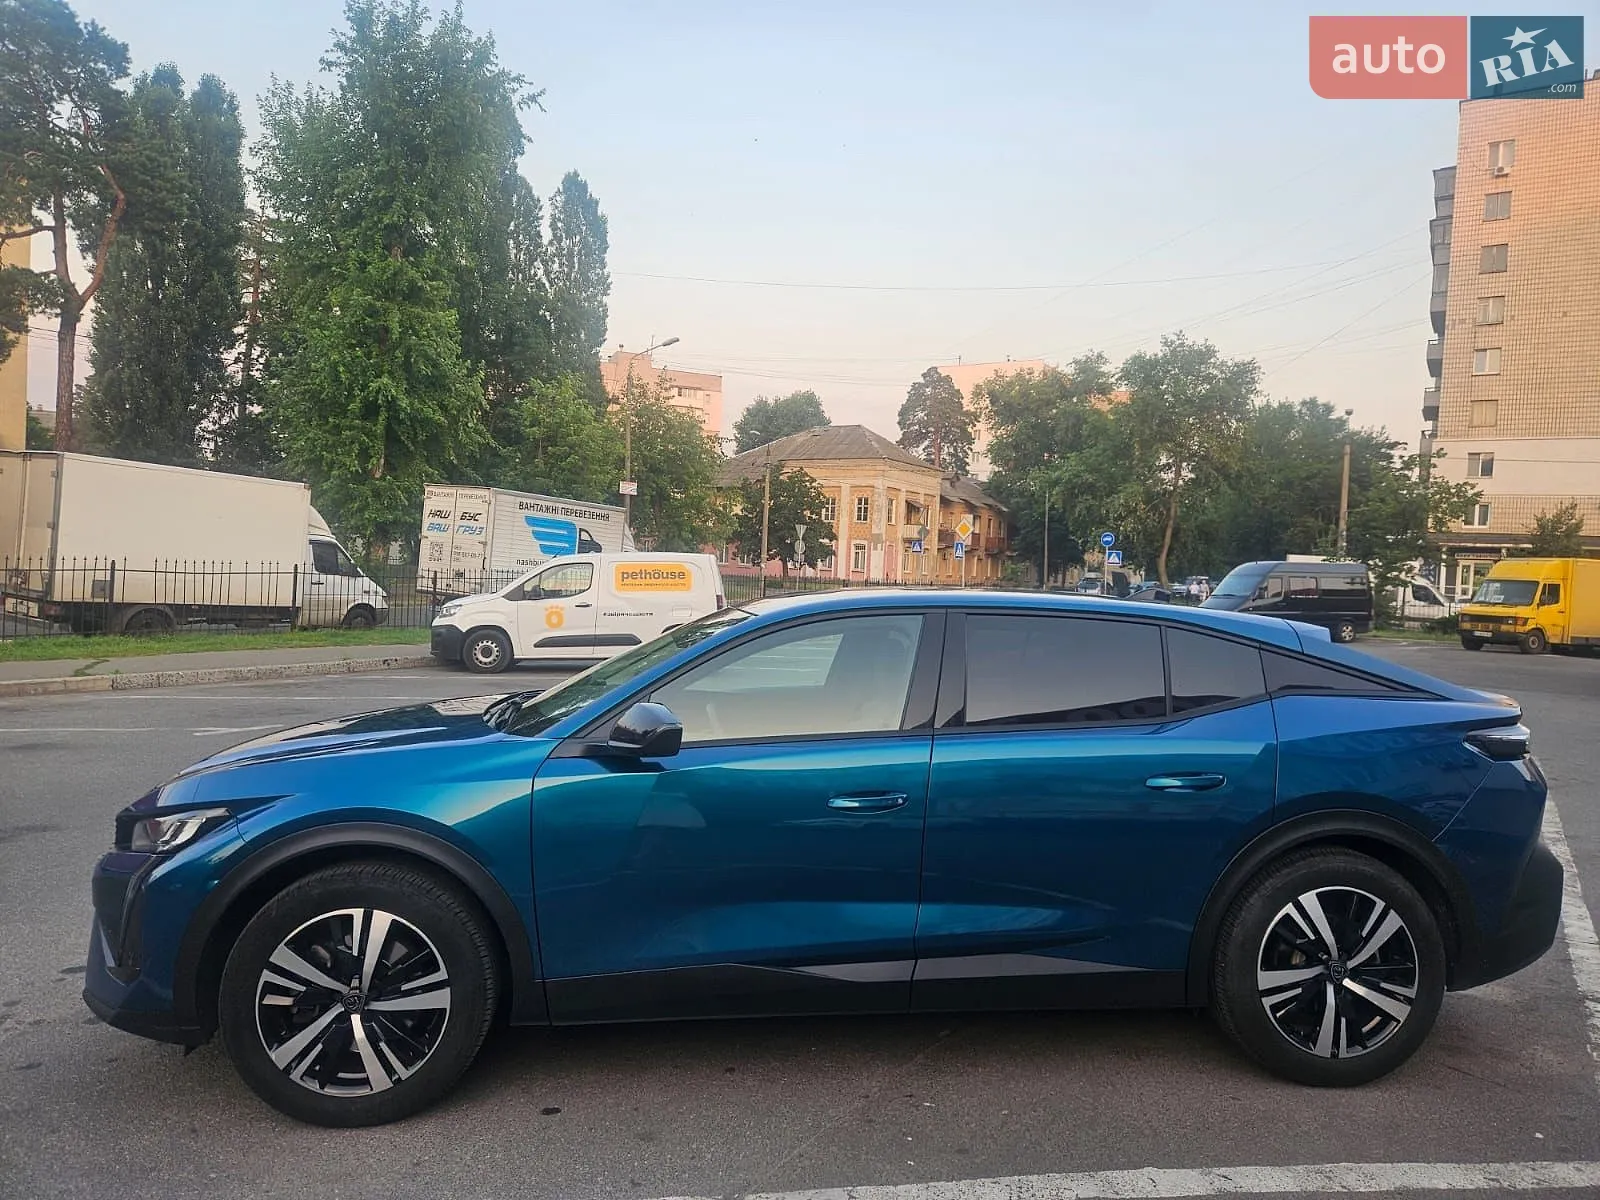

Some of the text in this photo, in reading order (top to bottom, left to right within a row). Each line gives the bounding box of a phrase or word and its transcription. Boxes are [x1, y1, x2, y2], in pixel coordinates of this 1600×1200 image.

[427, 509, 482, 521] НАШ БУС
[518, 501, 610, 521] ВАНТАЖНІ ПЕРЕВЕЗЕННЯ
[456, 524, 485, 535] ГРУЗ
[621, 568, 686, 582] pethouse
